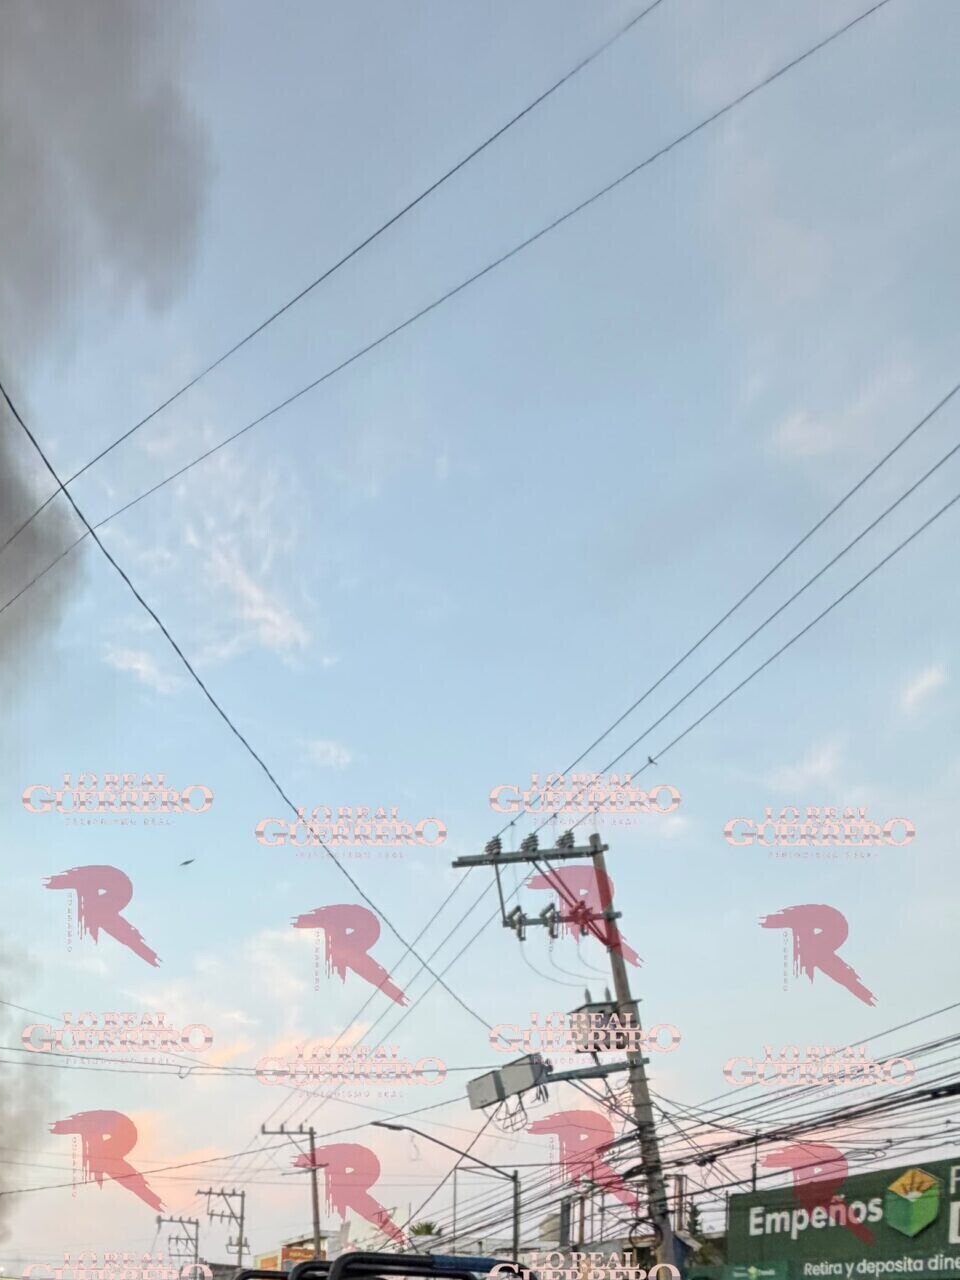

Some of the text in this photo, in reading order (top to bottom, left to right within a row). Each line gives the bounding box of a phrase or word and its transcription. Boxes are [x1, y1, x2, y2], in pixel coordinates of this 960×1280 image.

[749, 1195, 883, 1240] Empeños
[804, 1261, 843, 1276] Retira
[844, 1262, 855, 1280] y
[856, 1256, 924, 1278] deposita
